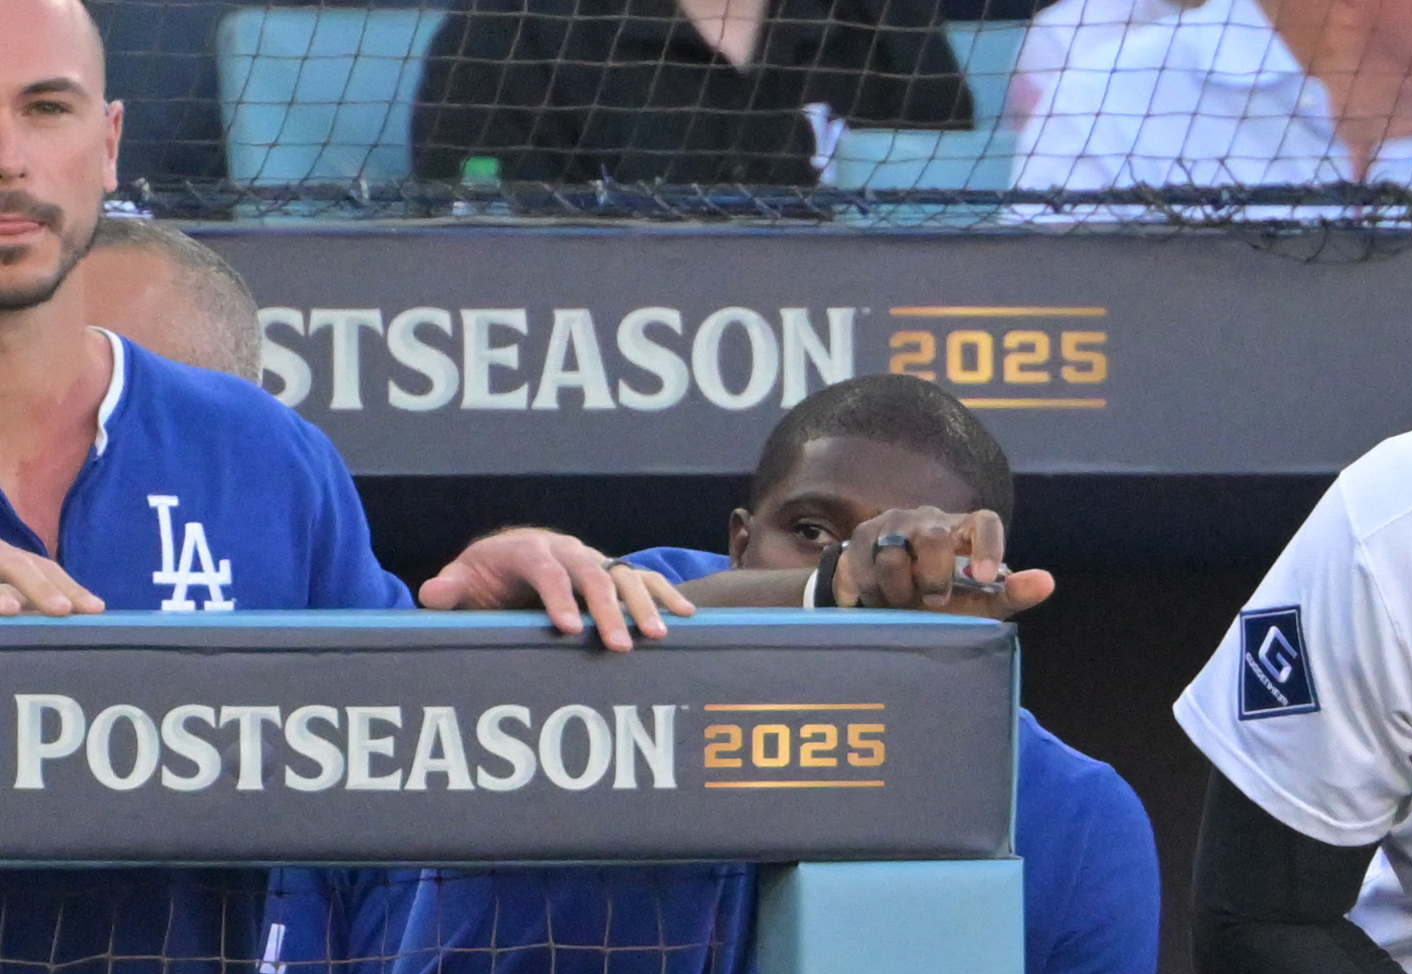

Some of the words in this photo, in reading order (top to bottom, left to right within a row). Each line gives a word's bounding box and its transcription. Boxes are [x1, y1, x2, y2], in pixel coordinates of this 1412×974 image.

[889, 330, 1107, 383] 2025
[146, 494, 235, 611] LA
[13, 693, 677, 790] POSTSEASON
[704, 723, 885, 767] 2025
